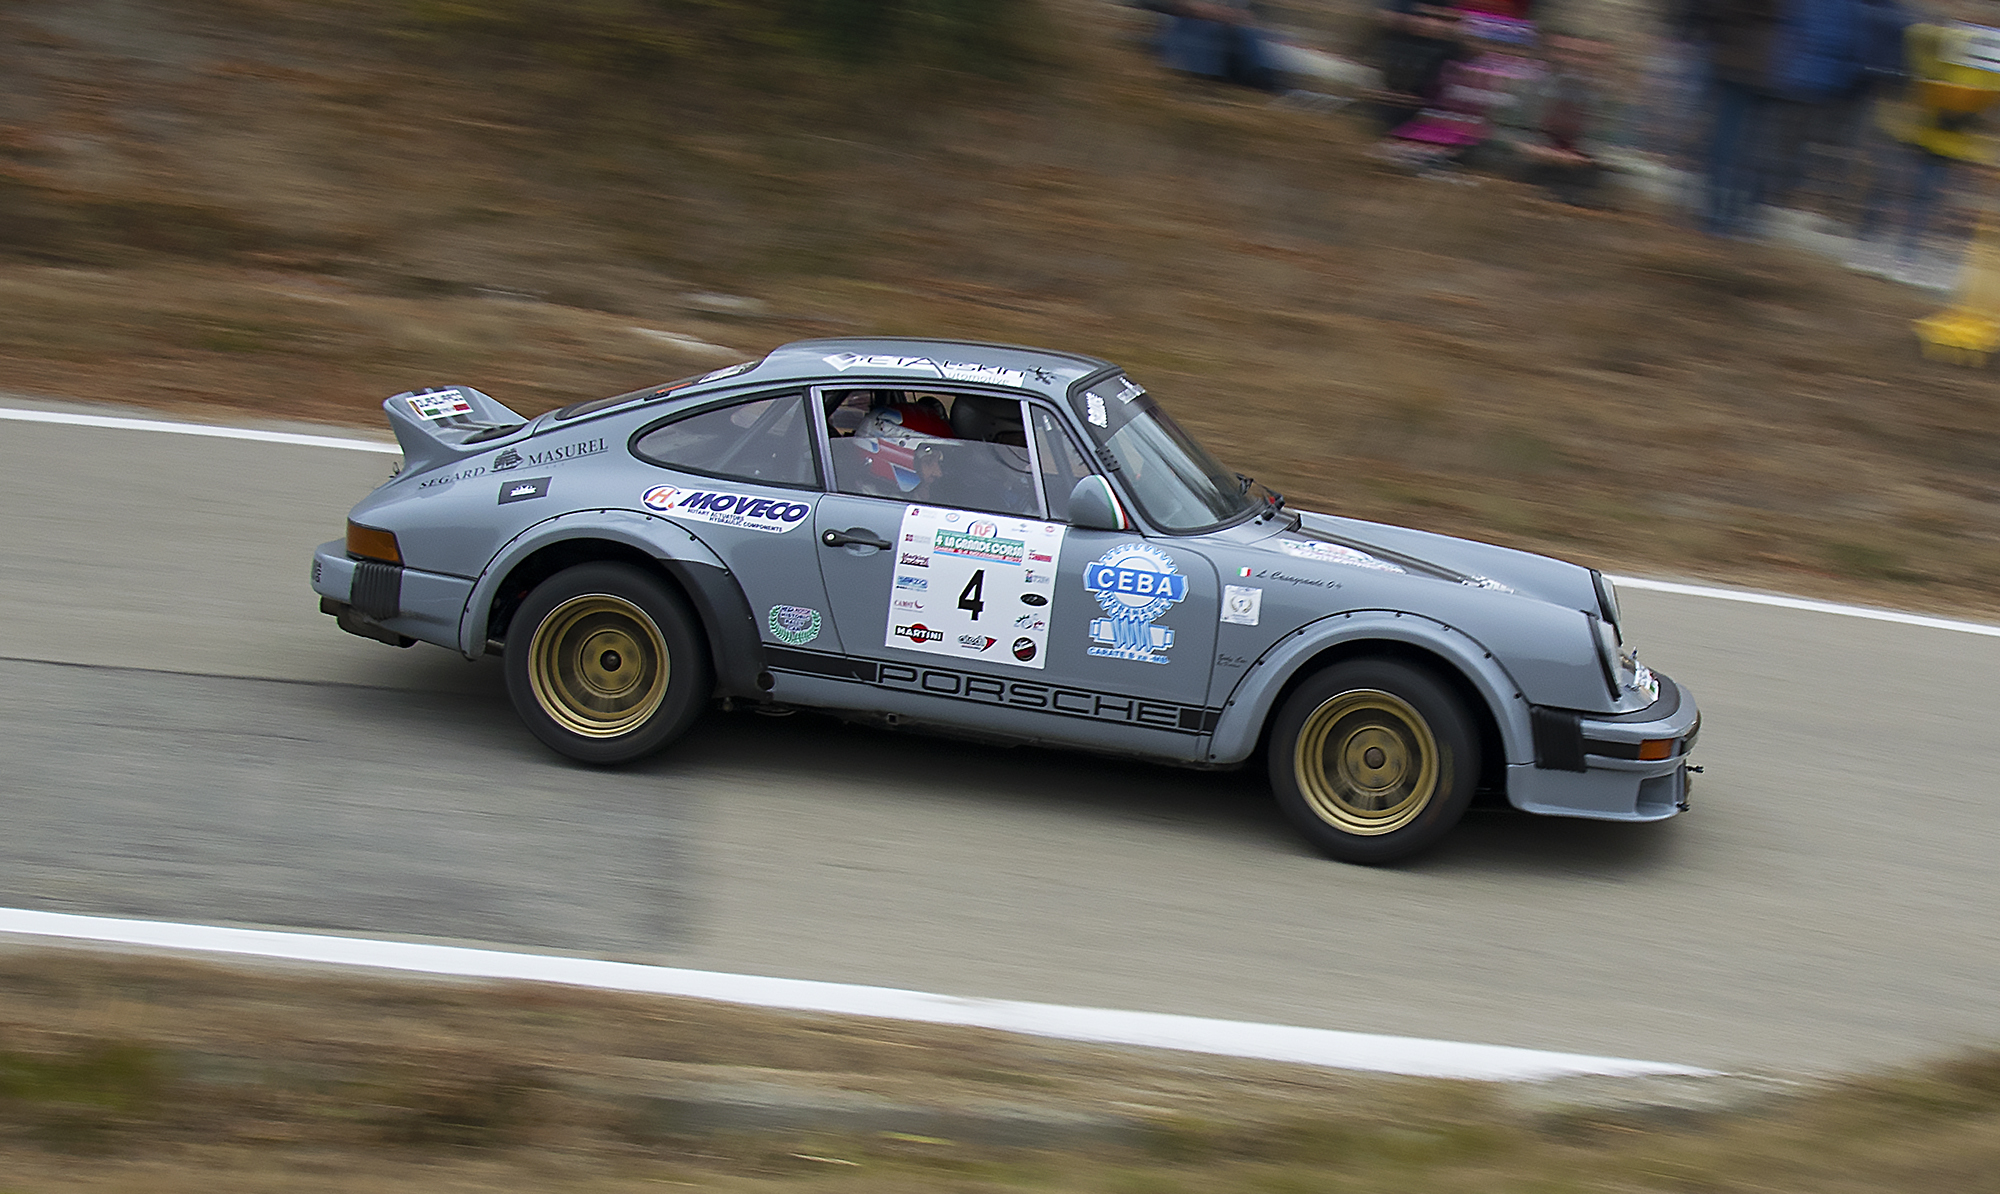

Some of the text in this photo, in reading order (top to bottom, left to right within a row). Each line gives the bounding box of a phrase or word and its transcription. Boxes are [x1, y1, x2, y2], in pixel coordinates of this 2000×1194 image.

[419, 437, 609, 489] SEGARD MASUREL
[677, 492, 810, 522] MOVECO
[944, 536, 956, 548] LA
[955, 538, 992, 553] GRANDE
[991, 542, 1024, 558] CORSA
[957, 569, 985, 621] 4
[1097, 568, 1174, 597] CEBA
[897, 626, 942, 640] MARTINI
[880, 666, 1179, 726] PORSCHE
